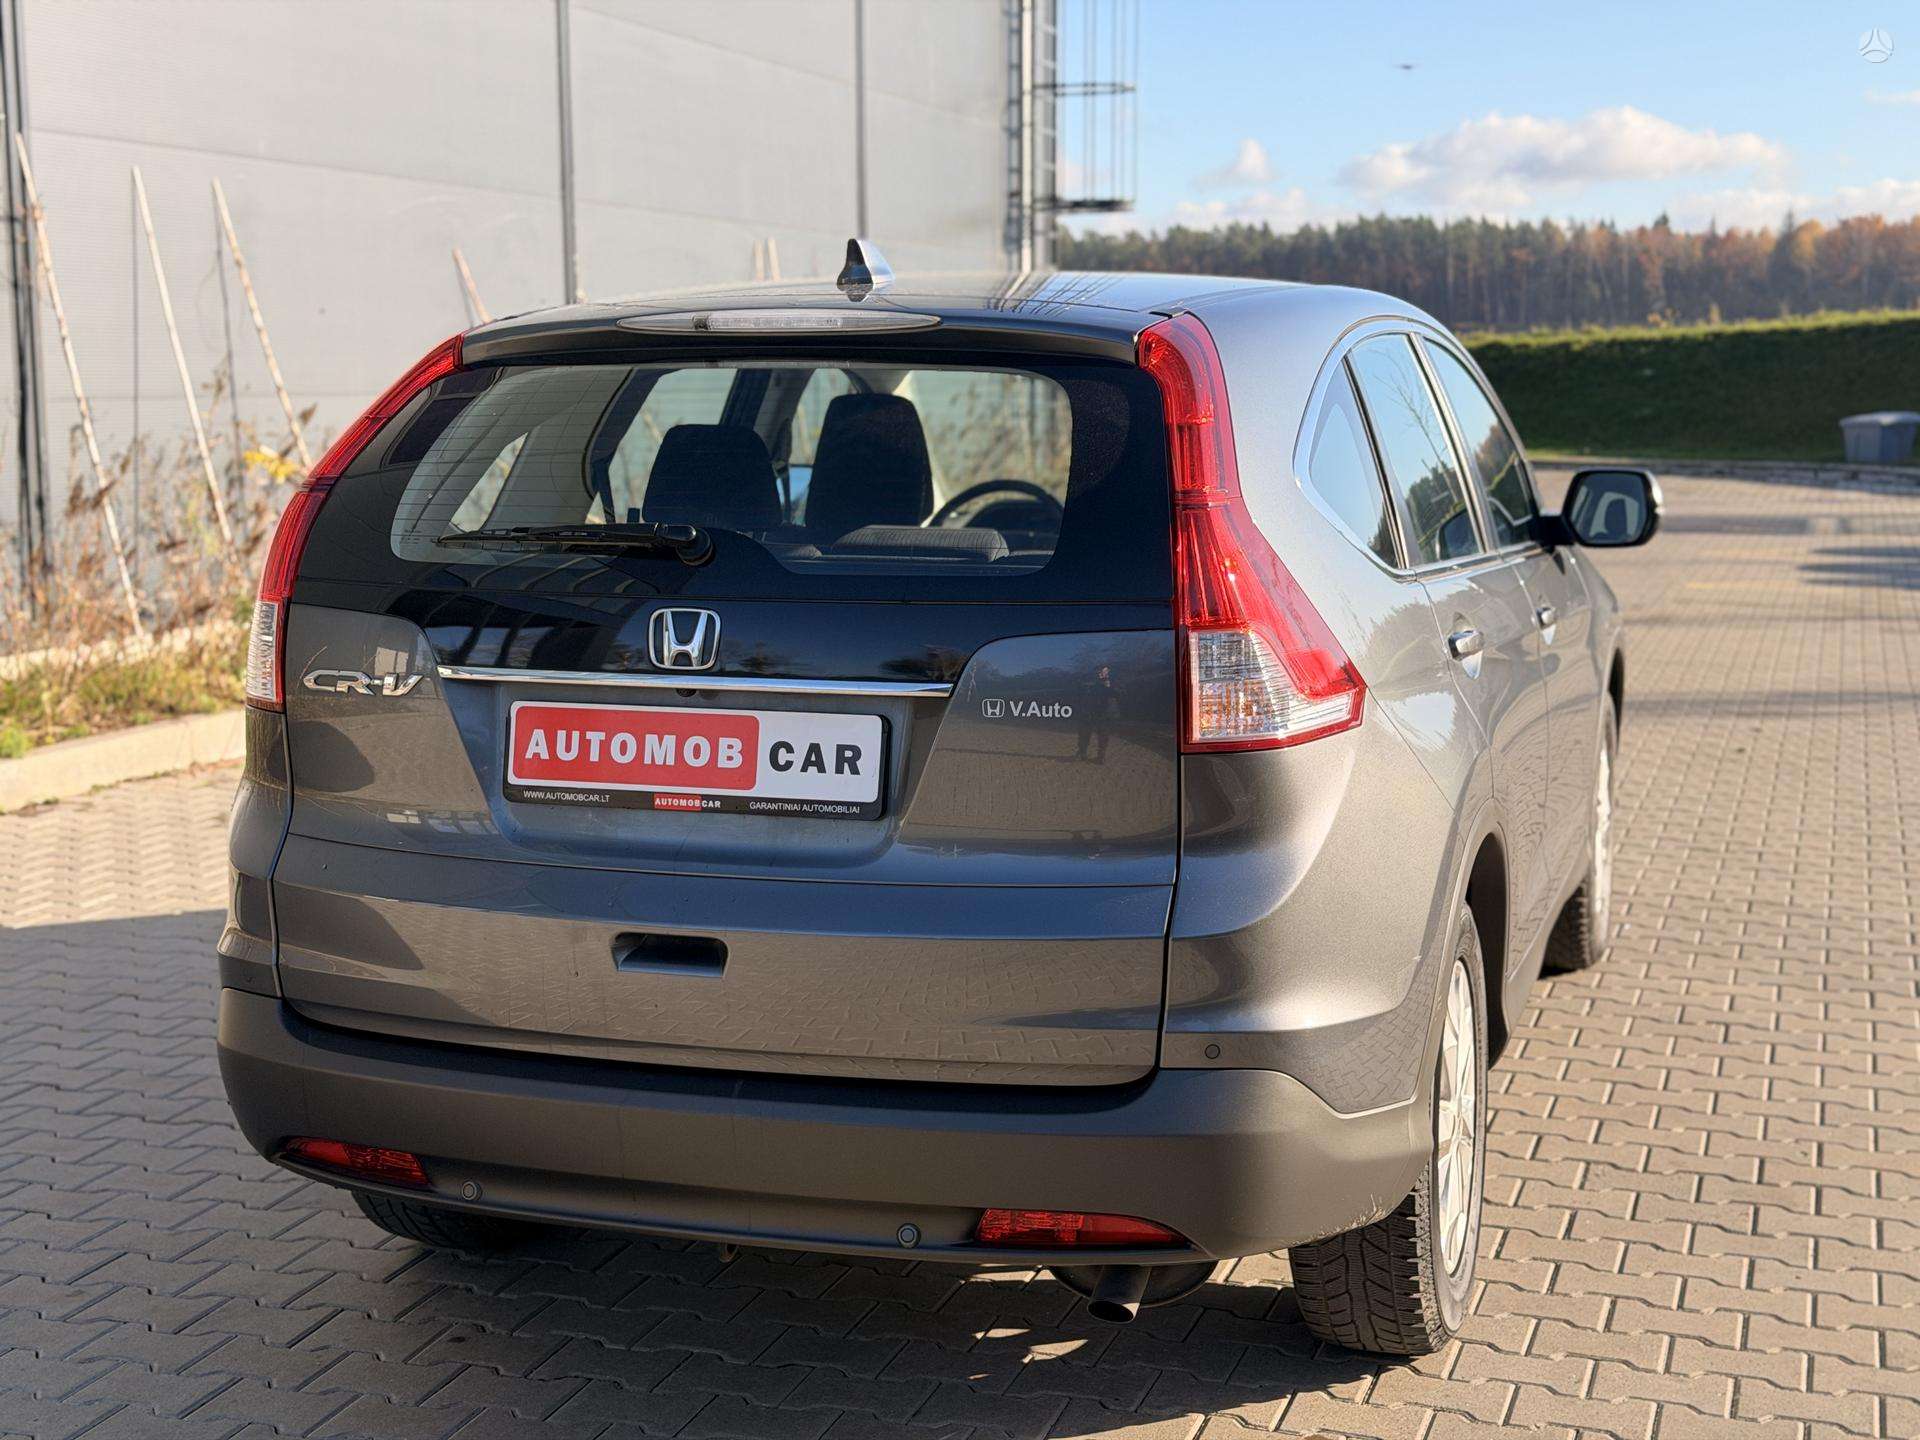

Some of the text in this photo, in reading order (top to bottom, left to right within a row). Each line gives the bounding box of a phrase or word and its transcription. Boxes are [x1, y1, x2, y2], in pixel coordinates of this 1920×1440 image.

[303, 669, 425, 697] CR-V
[1009, 700, 1073, 718] V.Auto
[524, 728, 862, 776] AUTOMOB CAR
[523, 790, 611, 803] WWW.AUTOMOBCAR.LT
